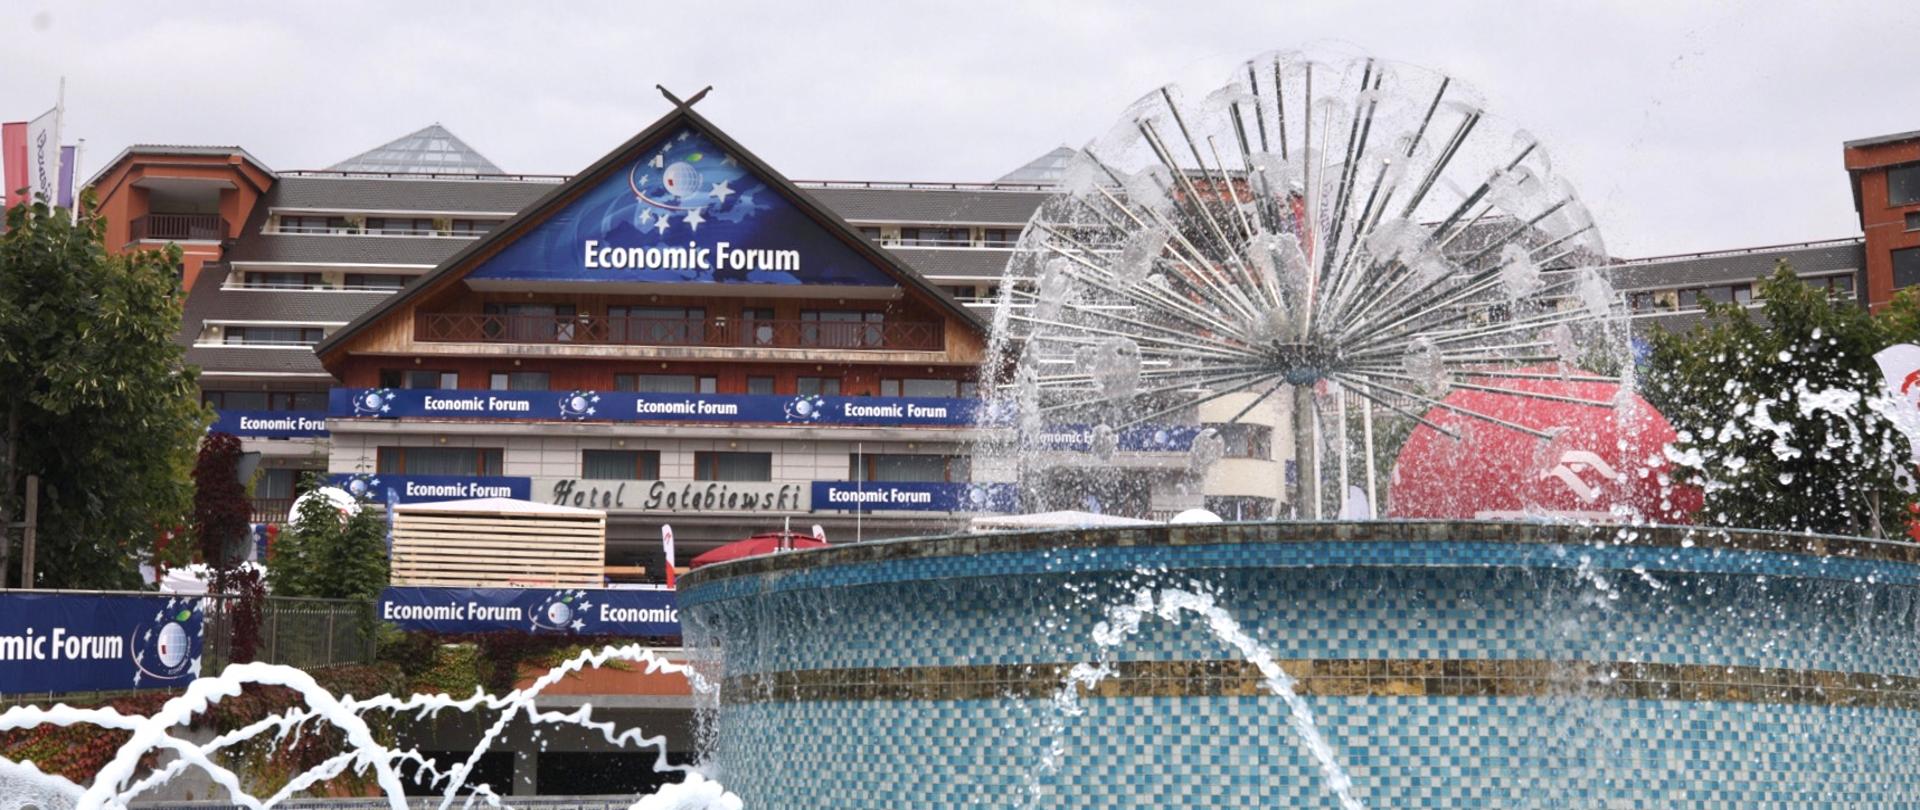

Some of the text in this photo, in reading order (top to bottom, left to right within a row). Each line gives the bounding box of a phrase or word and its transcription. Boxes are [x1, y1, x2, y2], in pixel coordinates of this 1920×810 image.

[584, 239, 800, 271] Economic Forum
[424, 395, 530, 412] Economic Forum
[636, 398, 738, 415] Economic Forum
[844, 402, 947, 418] Economic Forum
[240, 416, 326, 431] Economic Foru
[1032, 430, 1084, 444] onomic
[406, 481, 512, 499] Economic Forum
[553, 479, 626, 508] Hotel
[828, 487, 931, 503] Economic Forum
[384, 600, 679, 624] Economic Forum Economic
[51, 627, 123, 661] Forum
